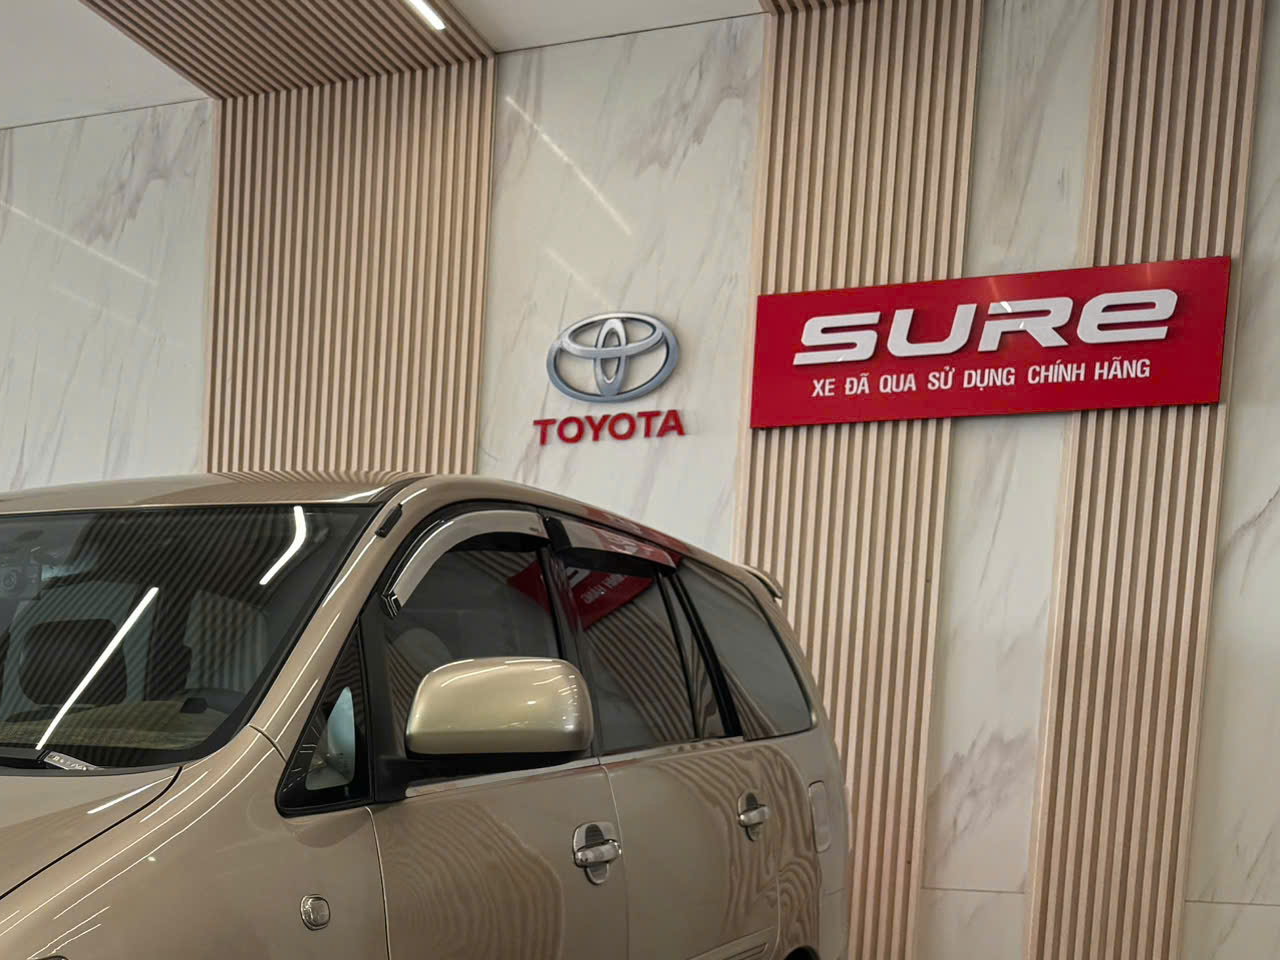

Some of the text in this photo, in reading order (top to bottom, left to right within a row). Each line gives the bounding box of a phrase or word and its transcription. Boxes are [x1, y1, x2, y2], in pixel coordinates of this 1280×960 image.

[811, 356, 1151, 398] XE ĐÃ QUA SỬ DỤNG CHÍNH HÃNG
[532, 409, 686, 447] TOYOTA
